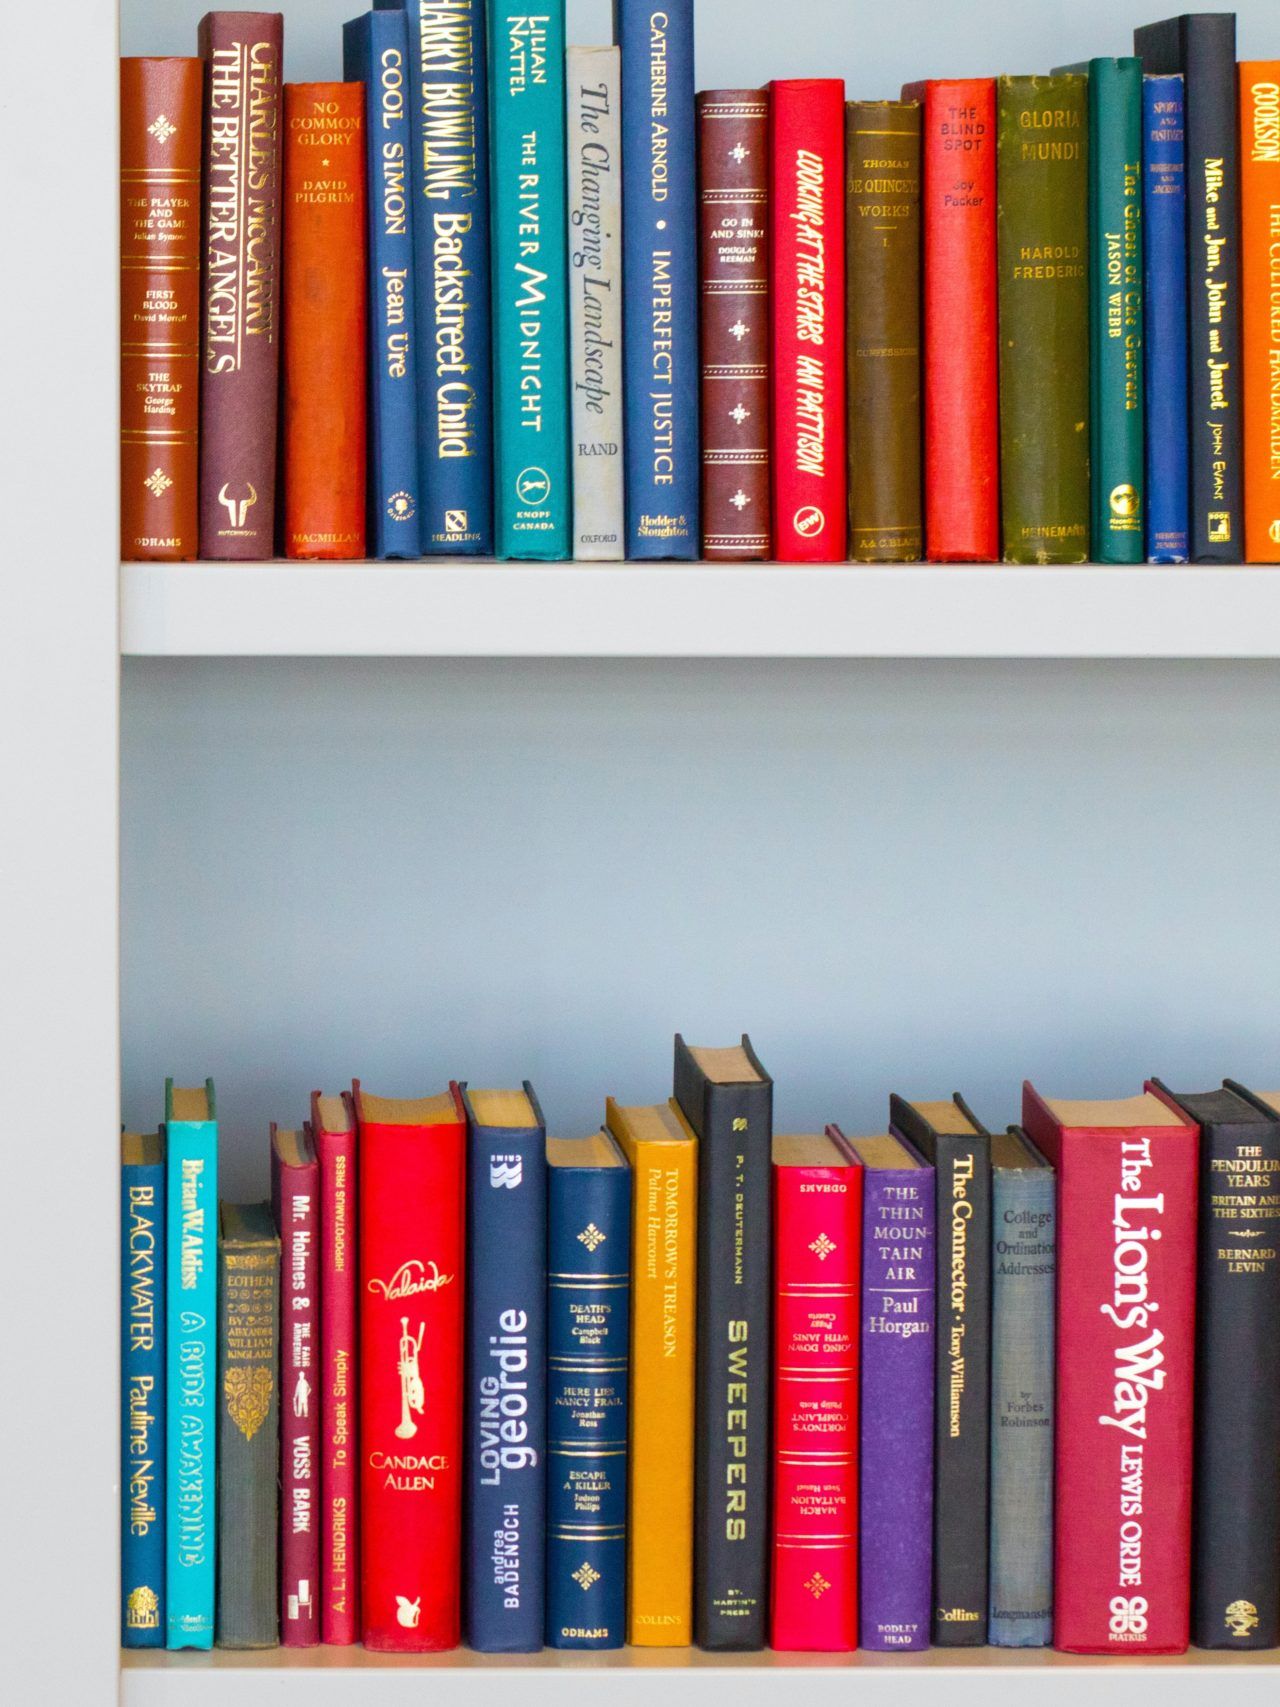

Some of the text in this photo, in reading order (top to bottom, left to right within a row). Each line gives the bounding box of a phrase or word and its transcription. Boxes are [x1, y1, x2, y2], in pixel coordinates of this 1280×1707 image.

[211, 42, 241, 109] THE
[507, 17, 528, 97] NATTEL
[528, 16, 550, 84] LILIAN
[313, 102, 339, 114] NO
[381, 48, 404, 130] COOL
[290, 117, 360, 130] COMMON
[298, 133, 353, 145] GLORY
[208, 116, 240, 242] BETTER
[382, 142, 406, 235] SIMON
[514, 131, 549, 431] THE RIVER MIDNIGHT
[571, 83, 613, 414] The Changing Landscape
[650, 12, 673, 485] CATHERINE ARNOLD IMPERFECT JUSTICE
[143, 301, 178, 310] BLOOD
[146, 290, 174, 299] FIRST
[382, 267, 408, 327] Jean
[1104, 232, 1122, 338] JASON WEBB
[578, 443, 618, 456] RAND
[516, 511, 551, 519] KNOPF
[580, 535, 617, 543] OXFORD
[335, 1155, 346, 1272] HIPPOPOTAMUS PRESS
[648, 1168, 662, 1279] Palma Harcourt
[735, 1155, 744, 1285] P. T. DEUTERMANN
[879, 1207, 923, 1219] THIN
[884, 1188, 919, 1200] THE
[292, 1196, 310, 1310] Mr. Holmes &
[663, 1168, 679, 1358] TOMORROW'S TREASON
[873, 1227, 932, 1239] MOUN-
[879, 1247, 923, 1260] TAIN
[368, 1260, 454, 1300] Valaida
[882, 1297, 918, 1314] Paul
[885, 1268, 916, 1280] AIR
[949, 1154, 974, 1438] The Connector Tony Williamson
[869, 1317, 930, 1337] Horgan
[129, 1186, 157, 1537] BLACKWATER Pauline Neville
[489, 1309, 537, 1469] geordie
[1099, 1138, 1167, 1588] The Lion's Way LEWIS ORDE
[333, 1350, 349, 1468] To Speak Simply
[480, 1376, 500, 1486] LOVING
[726, 1320, 748, 1541] SWEEPERS
[293, 1435, 310, 1534] VOSS BARK
[370, 1452, 449, 1470] CANDACE
[384, 1475, 434, 1490] ALLEN
[332, 1497, 346, 1613] A. L. HENDRIKS
[491, 1530, 504, 1584] andrea
[504, 1504, 519, 1608] BADENOCH
[878, 1624, 918, 1633] BODLEY
[884, 1634, 912, 1643] HEAD
[1109, 1633, 1147, 1641] PIATKUS
